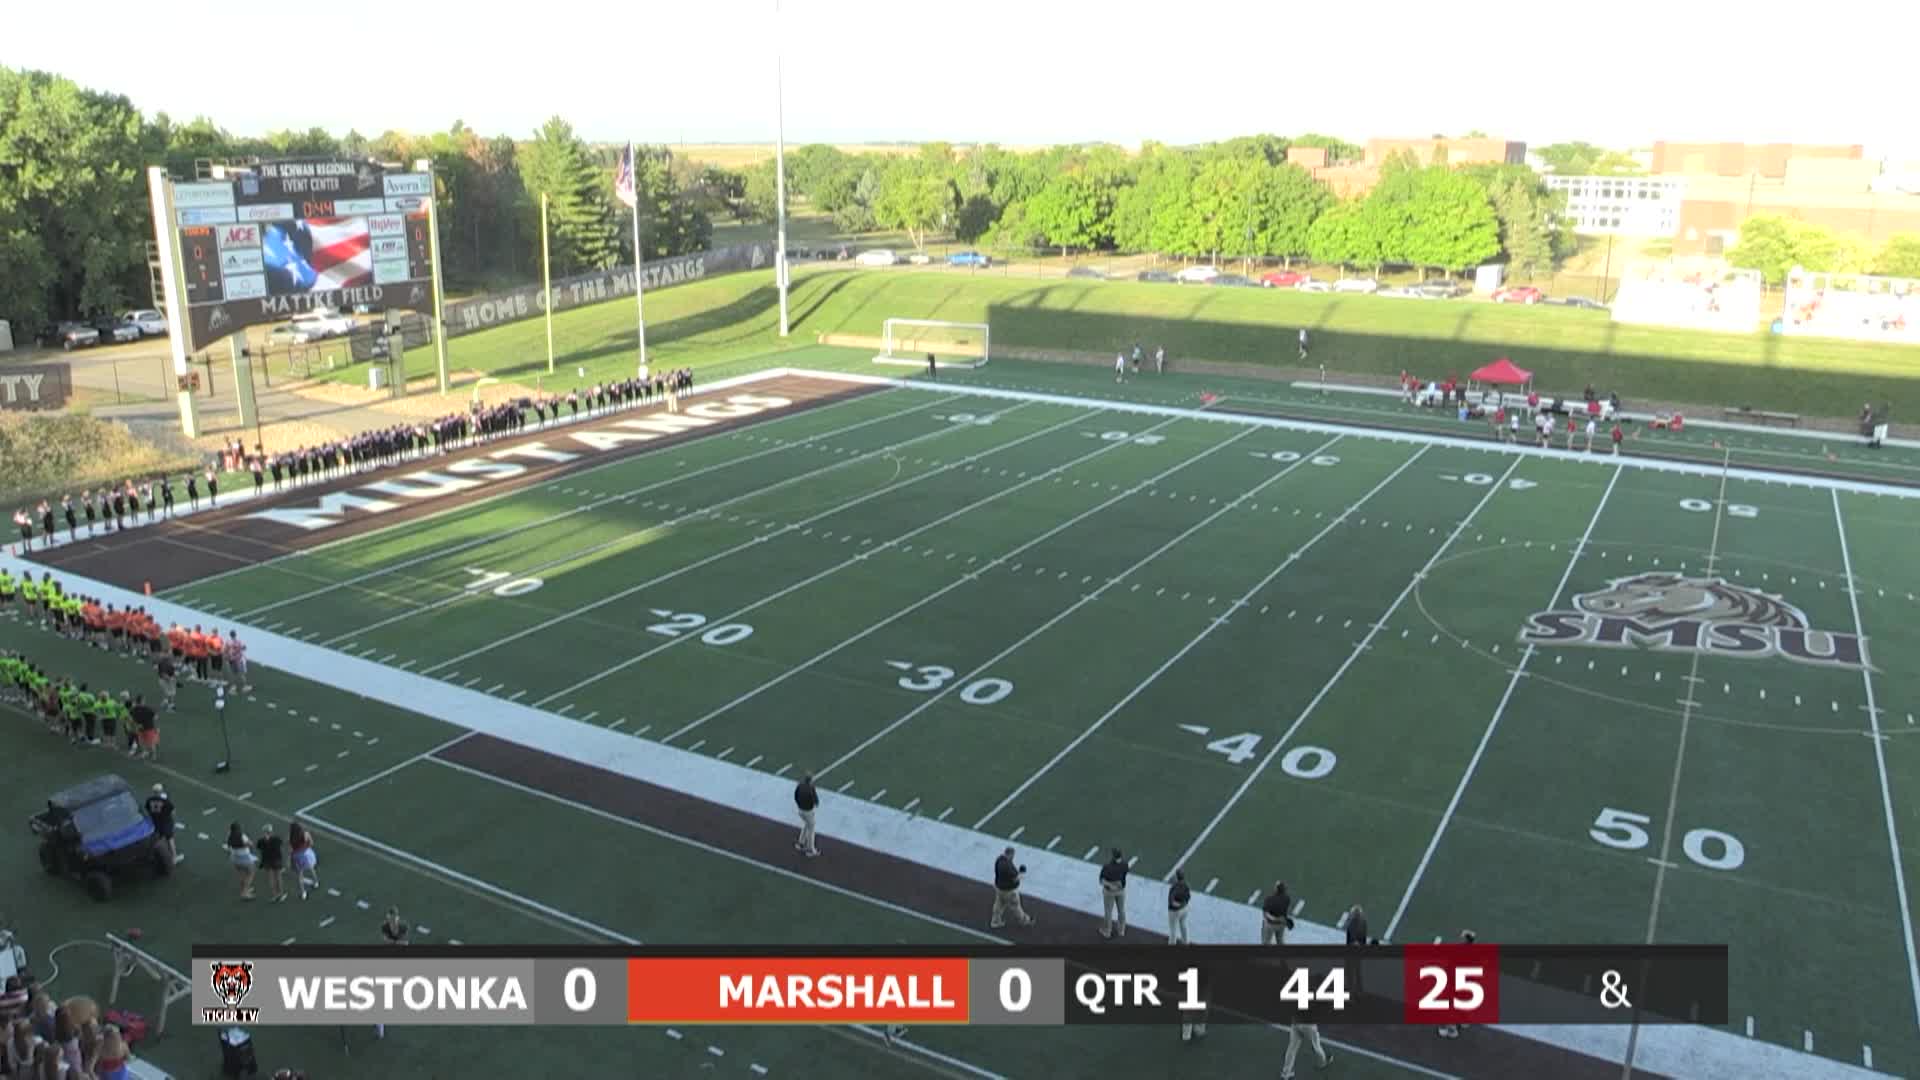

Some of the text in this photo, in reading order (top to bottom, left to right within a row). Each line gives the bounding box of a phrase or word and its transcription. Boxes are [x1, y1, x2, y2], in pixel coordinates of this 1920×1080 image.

[316, 161, 355, 176] REGIONAL
[283, 176, 339, 192] EVENT CENTER
[225, 226, 255, 242] ACE
[261, 286, 384, 313] MATTKE FIELD
[463, 295, 528, 329] HOME
[536, 286, 561, 311] OF
[570, 278, 606, 303] THE
[240, 393, 793, 530] MUSTANGS
[1517, 610, 1875, 669] SMSU
